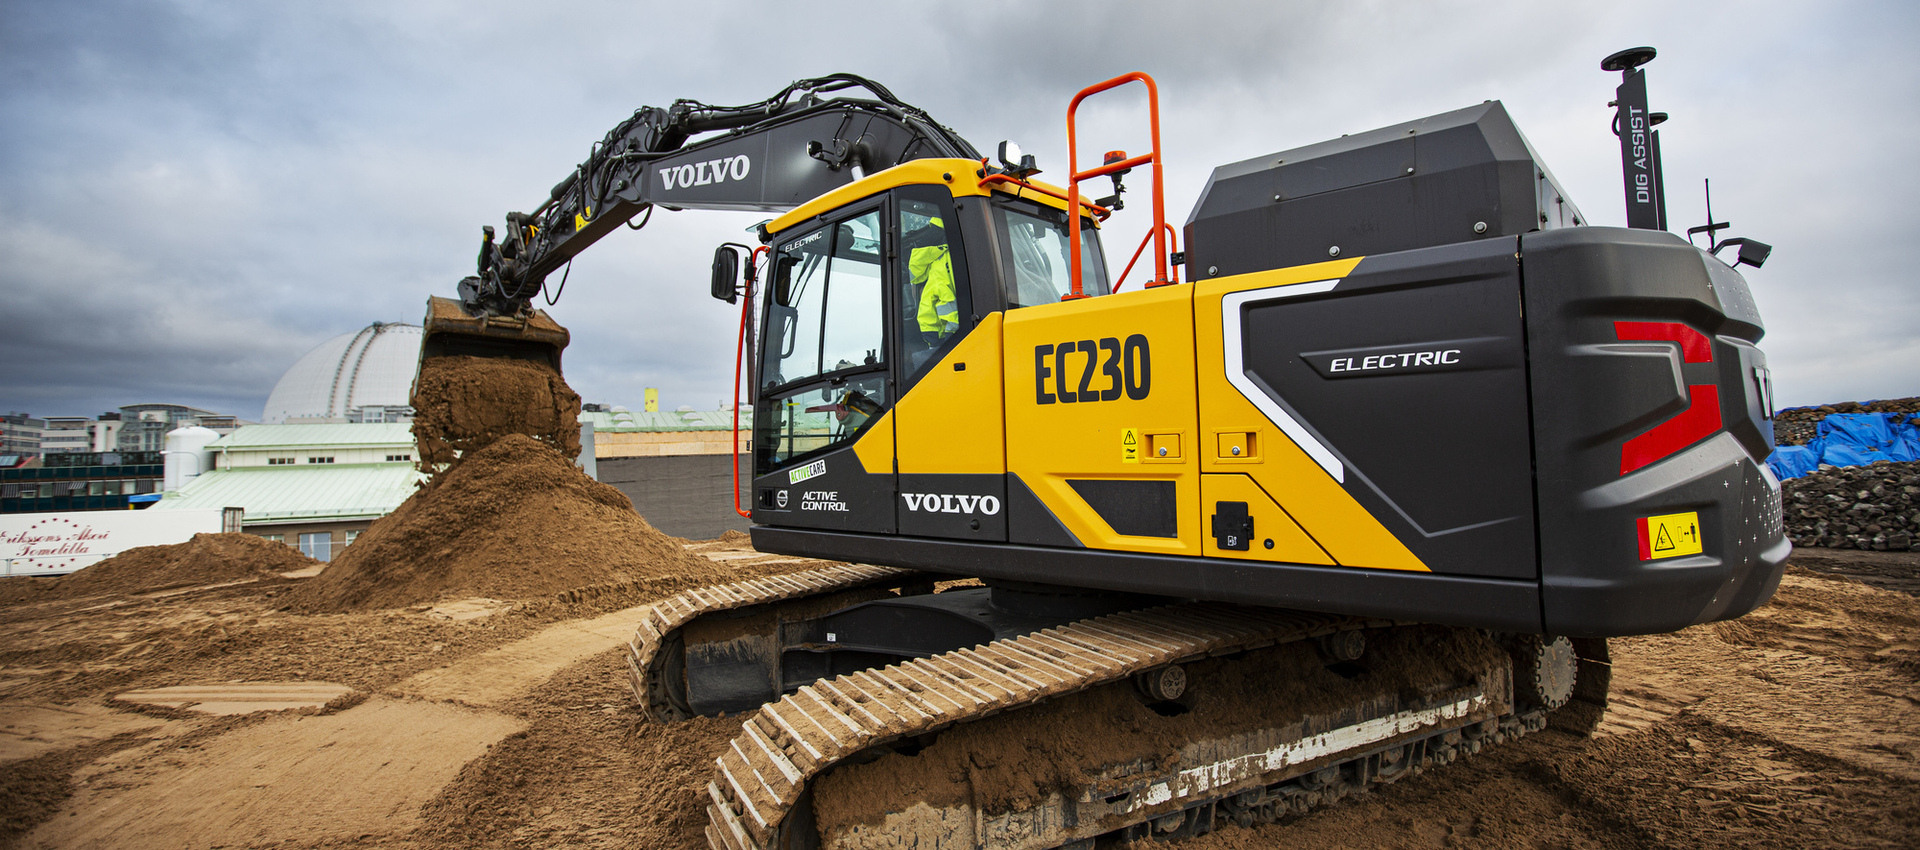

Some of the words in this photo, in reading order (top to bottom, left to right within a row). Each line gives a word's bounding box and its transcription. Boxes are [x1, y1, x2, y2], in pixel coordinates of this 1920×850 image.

[1629, 105, 1646, 169] ASSIST
[659, 154, 751, 190] VOLVO
[1635, 173, 1649, 203] DIG
[784, 231, 823, 253] ELECTRIC
[1035, 333, 1151, 405] EC230
[1330, 349, 1460, 372] ELECTRIC
[801, 501, 850, 512] CONTROL
[802, 491, 838, 501] ACTIVE
[901, 493, 1001, 516] VOLVO
[16, 542, 89, 556] Tomelilla
